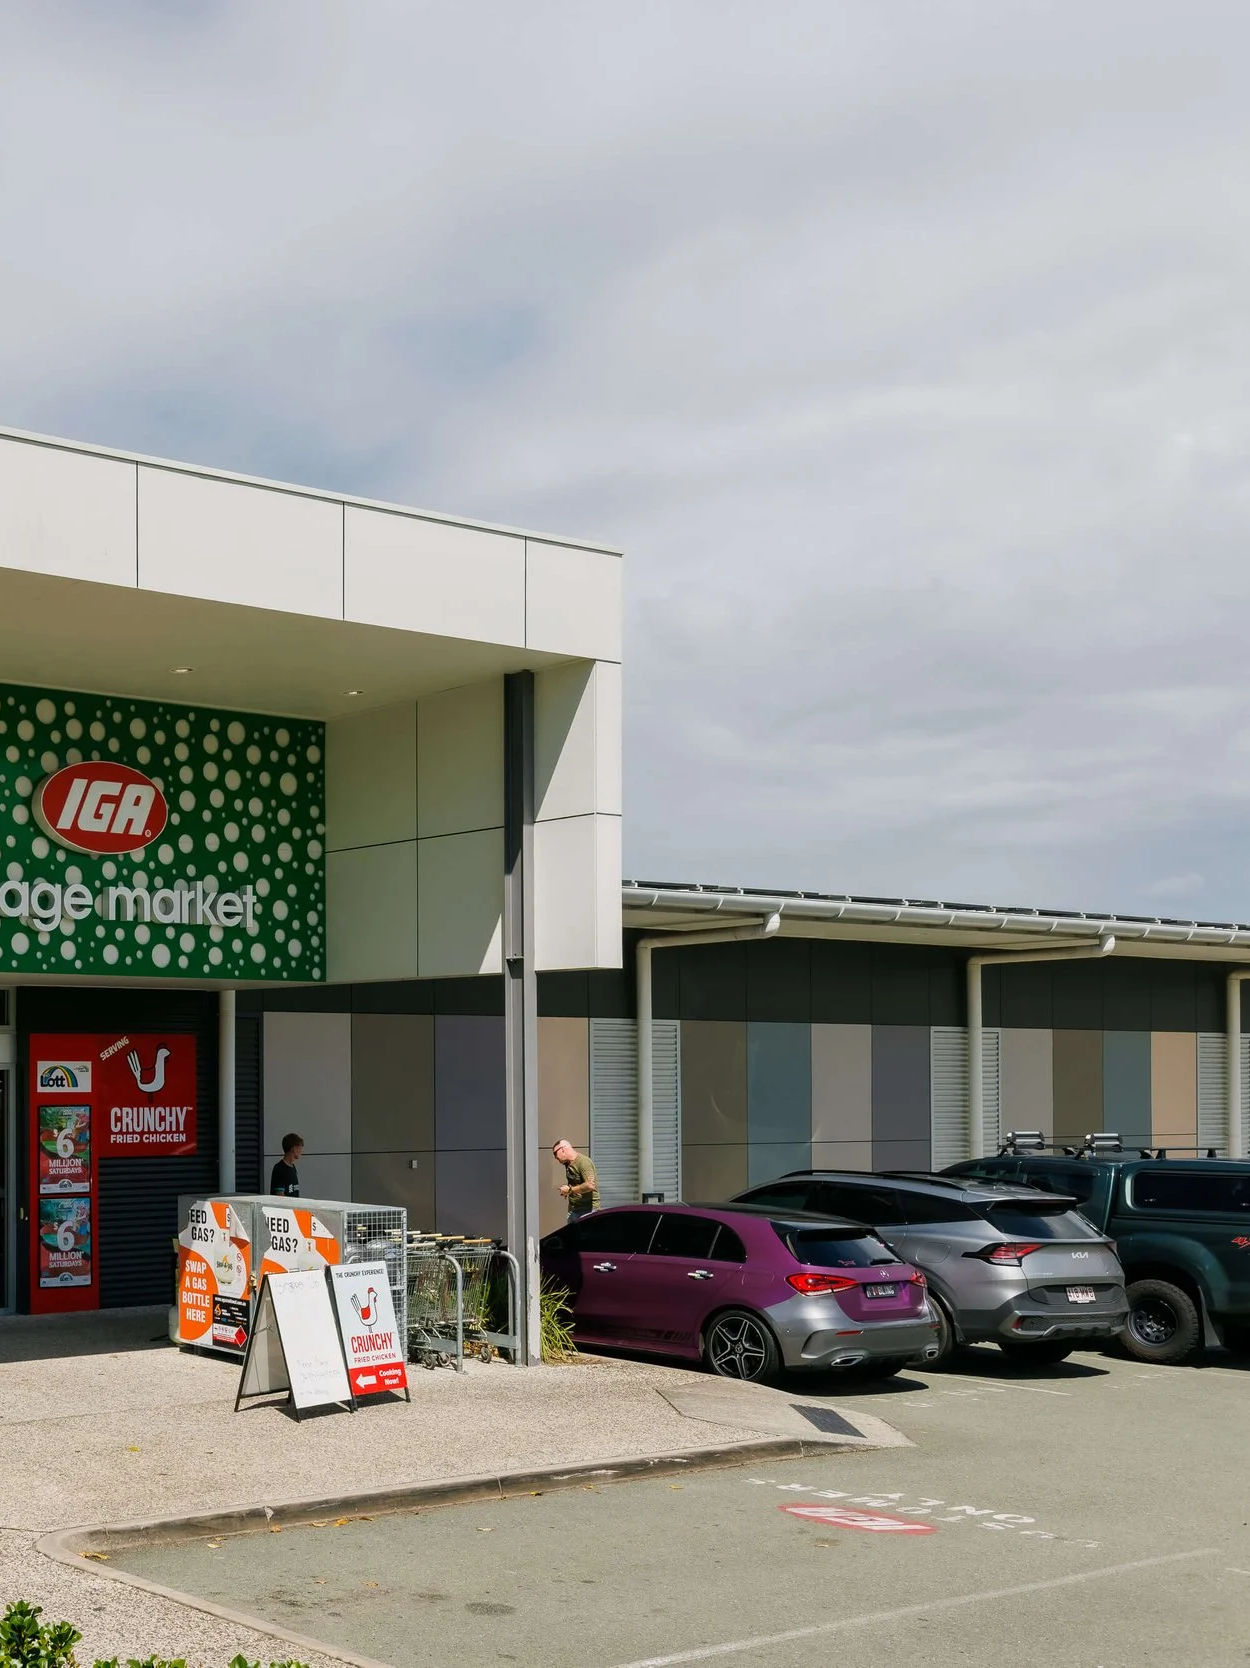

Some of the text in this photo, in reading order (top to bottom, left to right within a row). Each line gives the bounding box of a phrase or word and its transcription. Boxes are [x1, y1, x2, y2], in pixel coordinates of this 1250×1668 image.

[57, 779, 154, 836] IGA
[107, 881, 256, 928] market
[100, 1036, 130, 1060] SERVING
[41, 1075, 65, 1087] Lott
[111, 1107, 187, 1133] CRUNCHY
[111, 1133, 186, 1143] FRIED CHICKEN
[49, 1167, 82, 1175] SATURDAYS
[188, 1209, 206, 1224] EED
[192, 1227, 214, 1243] GAS?
[272, 1236, 298, 1253] GAS?
[49, 1260, 82, 1268] SATURDAYS
[186, 1260, 206, 1271] SWAP
[185, 1277, 206, 1290] A GAS
[182, 1292, 210, 1307] BOTTLE
[186, 1308, 206, 1323] HERE
[351, 1333, 393, 1353] CRUNCHY
[354, 1352, 396, 1363] FRIED CHICKEN
[379, 1368, 402, 1378] Cooking
[385, 1377, 398, 1386] Now!
[868, 1492, 1036, 1524] ONLY
